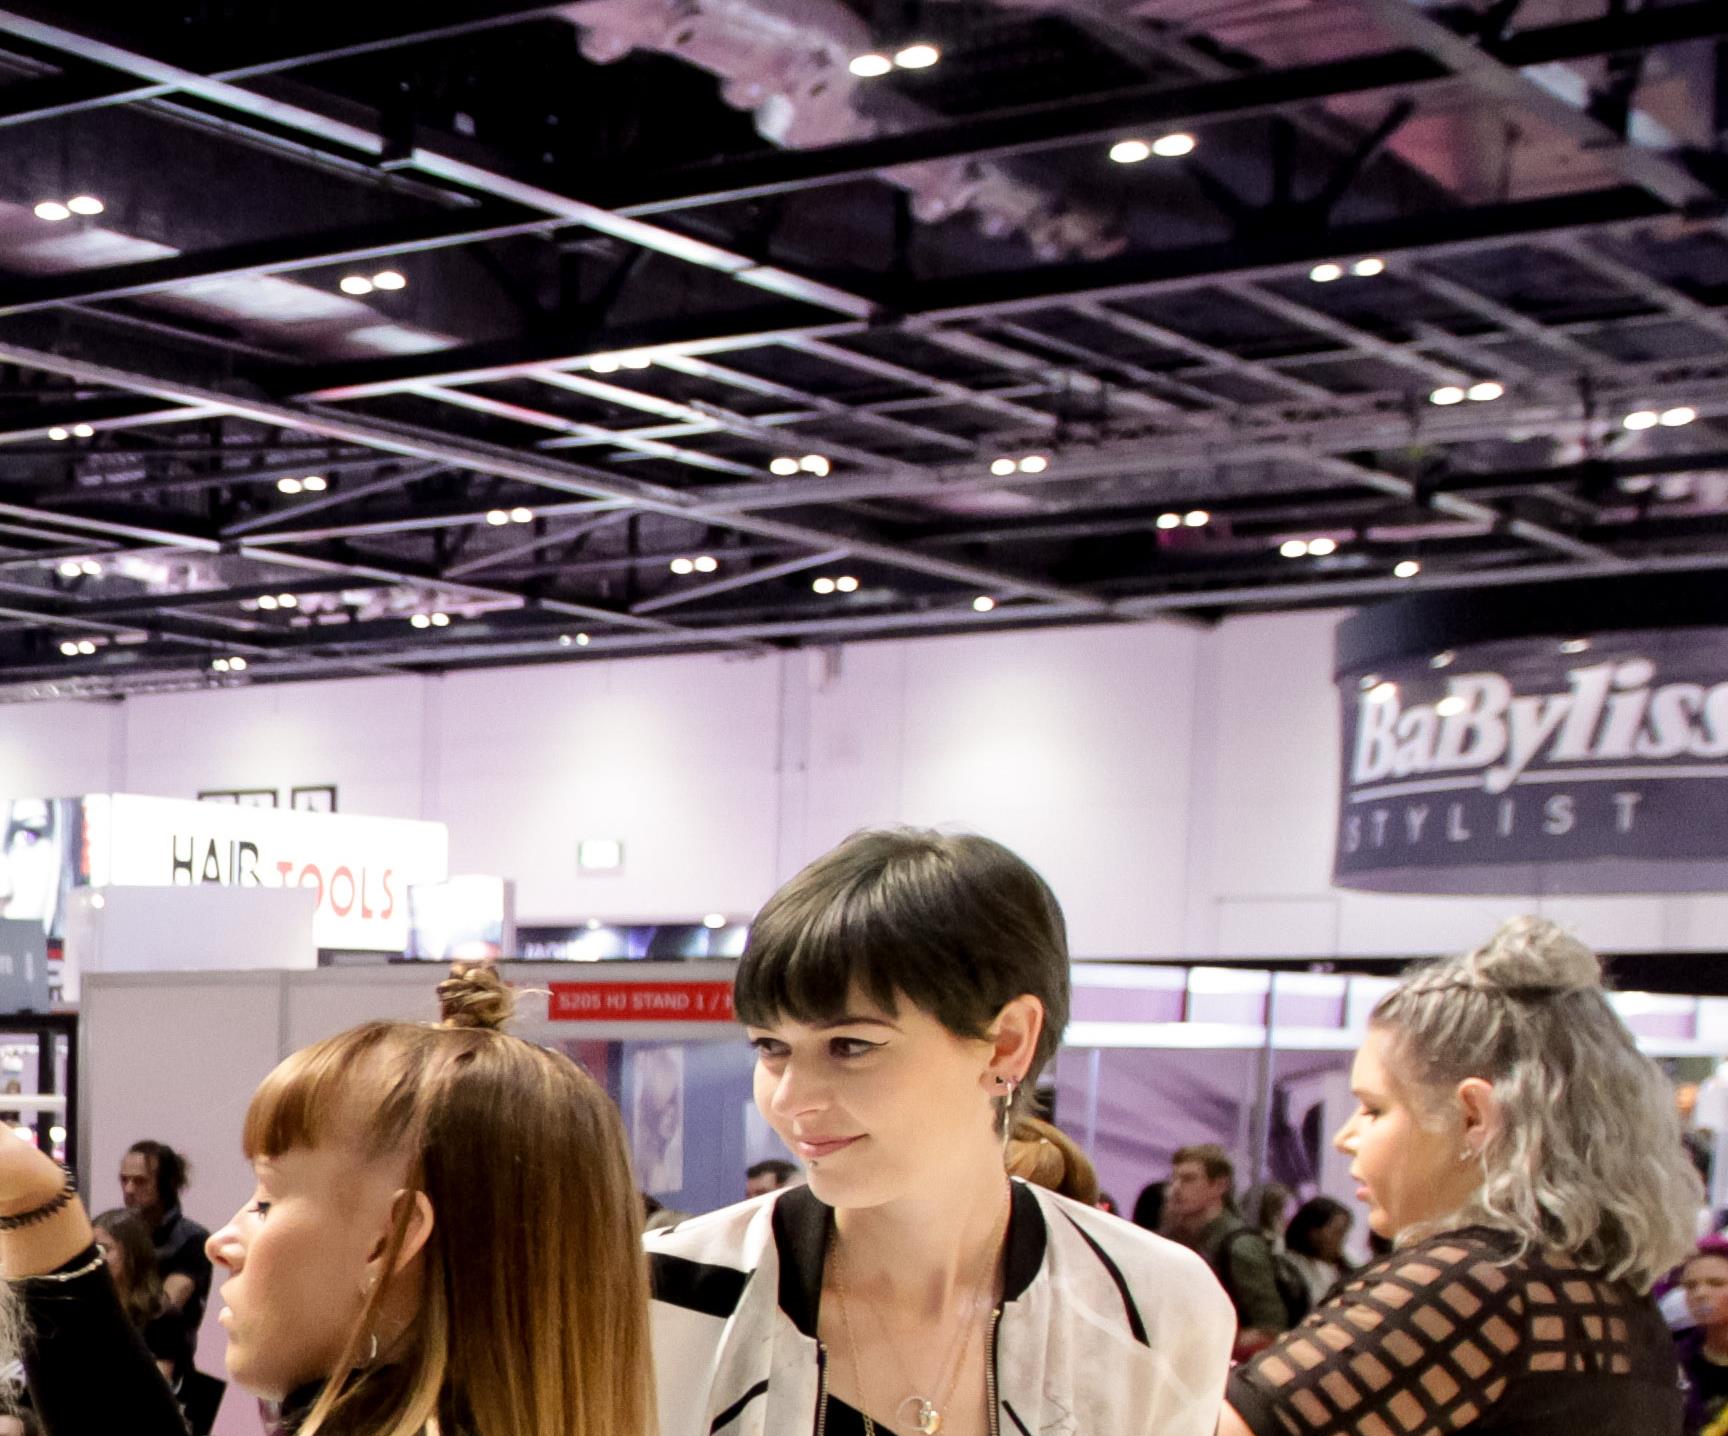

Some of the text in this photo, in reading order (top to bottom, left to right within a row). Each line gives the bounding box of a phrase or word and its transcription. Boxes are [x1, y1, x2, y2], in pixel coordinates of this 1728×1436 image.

[1343, 792, 1642, 853] STYLIST
[172, 834, 394, 920] HAIR TOOLS
[632, 992, 690, 1010] STAND
